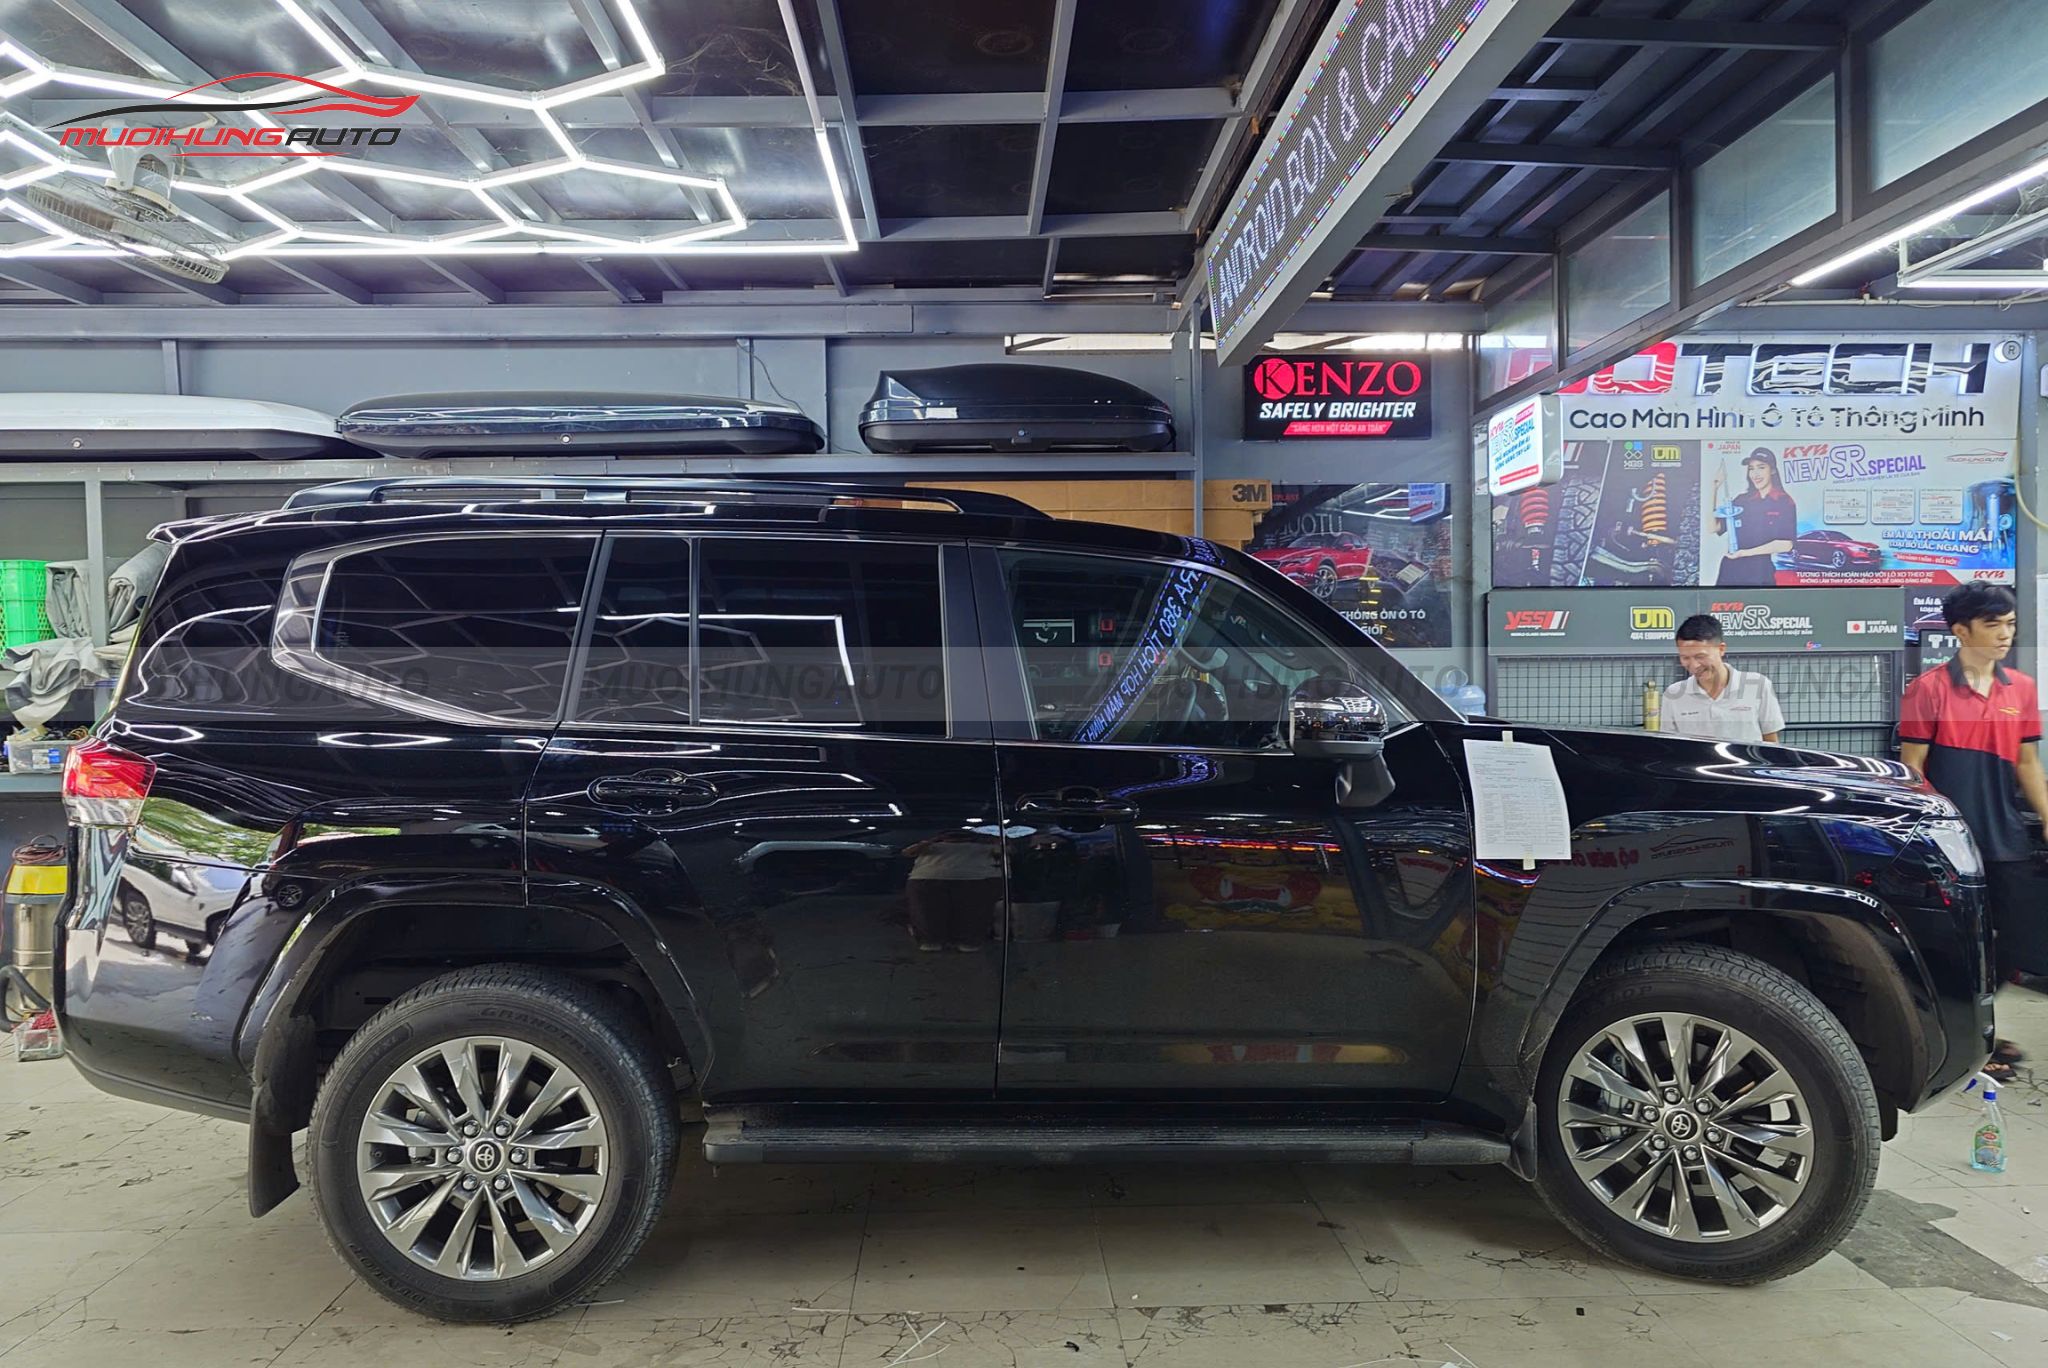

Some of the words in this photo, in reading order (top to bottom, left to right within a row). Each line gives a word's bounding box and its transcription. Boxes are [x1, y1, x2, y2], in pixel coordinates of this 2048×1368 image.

[1218, 178, 1286, 318] ANDROID
[1286, 95, 1338, 217] BOX
[1337, 66, 1360, 141] &
[1254, 358, 1422, 400] KENZO
[1259, 402, 1326, 419] SAFELY
[1328, 402, 1416, 418] BRIGHTER
[1569, 409, 1627, 429] Cao
[1632, 407, 1689, 429] Màn
[1696, 406, 1755, 428] Hình
[1761, 402, 1783, 428] Ô
[1791, 405, 1824, 428] Tô
[1830, 405, 1918, 433] Thông
[1922, 405, 1985, 427] Minh
[1783, 443, 1829, 459] KYB
[1783, 456, 1829, 484] NEW
[1830, 444, 1868, 479] SR
[1868, 454, 1926, 475] SPECIAL
[1232, 484, 1267, 502] 3M
[1959, 527, 1993, 542] MÁI
[1936, 542, 1979, 554] NGANG
[1744, 605, 1771, 629] SR
[1769, 617, 1813, 629] SPECIAL
[1867, 625, 1897, 633] JAPAN
